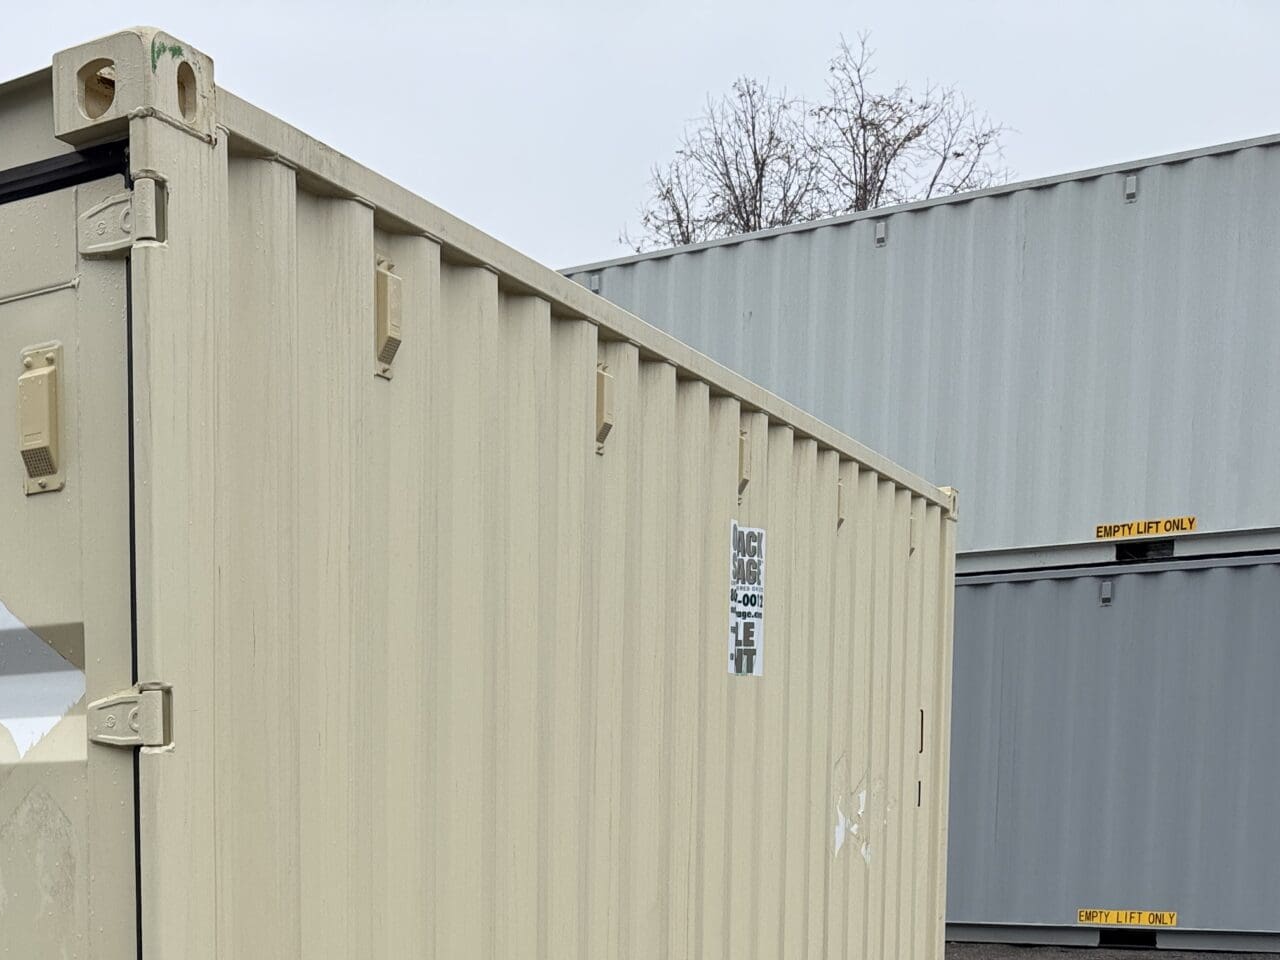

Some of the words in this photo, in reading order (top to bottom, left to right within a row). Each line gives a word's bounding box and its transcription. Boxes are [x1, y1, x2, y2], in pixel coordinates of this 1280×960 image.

[1096, 523, 1133, 538] EMPTY
[1136, 521, 1161, 535] LIFT
[1164, 517, 1196, 532] ONLY
[1078, 910, 1111, 923] EMPTY
[1116, 911, 1143, 924] LIFT
[1148, 912, 1176, 925] ONLY
